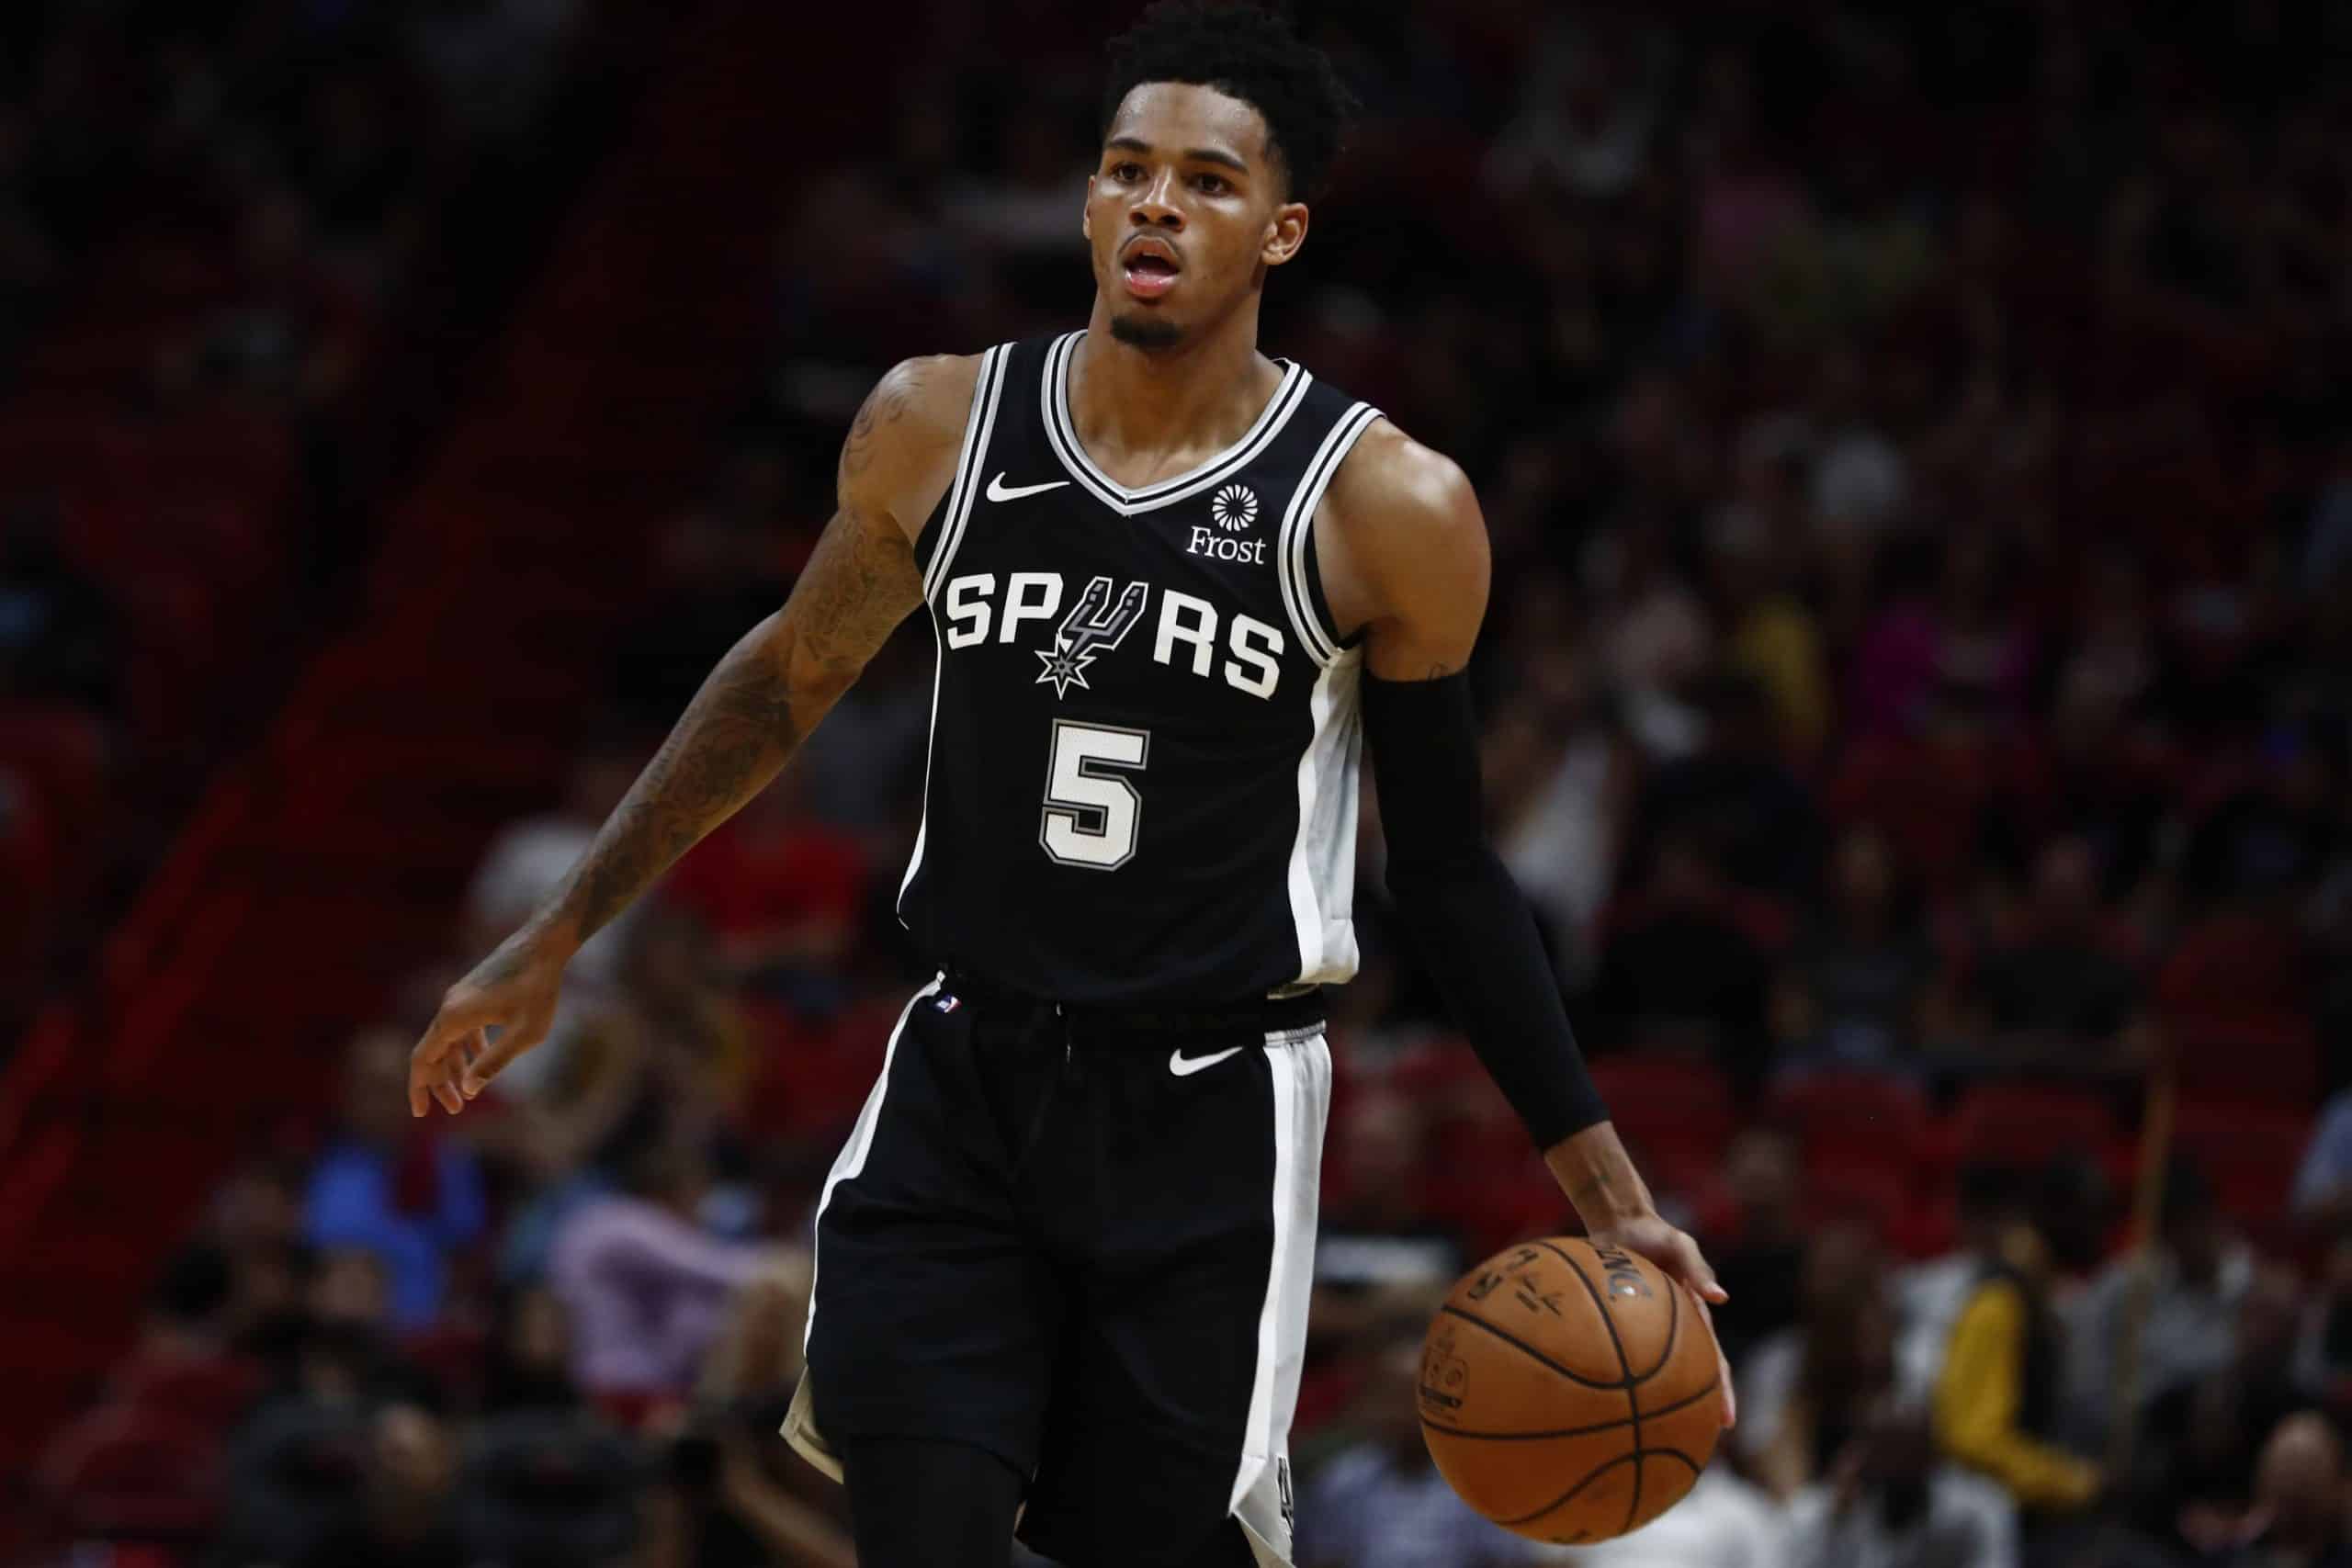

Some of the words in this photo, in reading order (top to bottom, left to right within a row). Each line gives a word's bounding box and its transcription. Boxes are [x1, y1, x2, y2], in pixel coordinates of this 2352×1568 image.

[1186, 525, 1267, 565] Frost
[945, 571, 1284, 701] SPURS
[1038, 718, 1151, 872] 5
